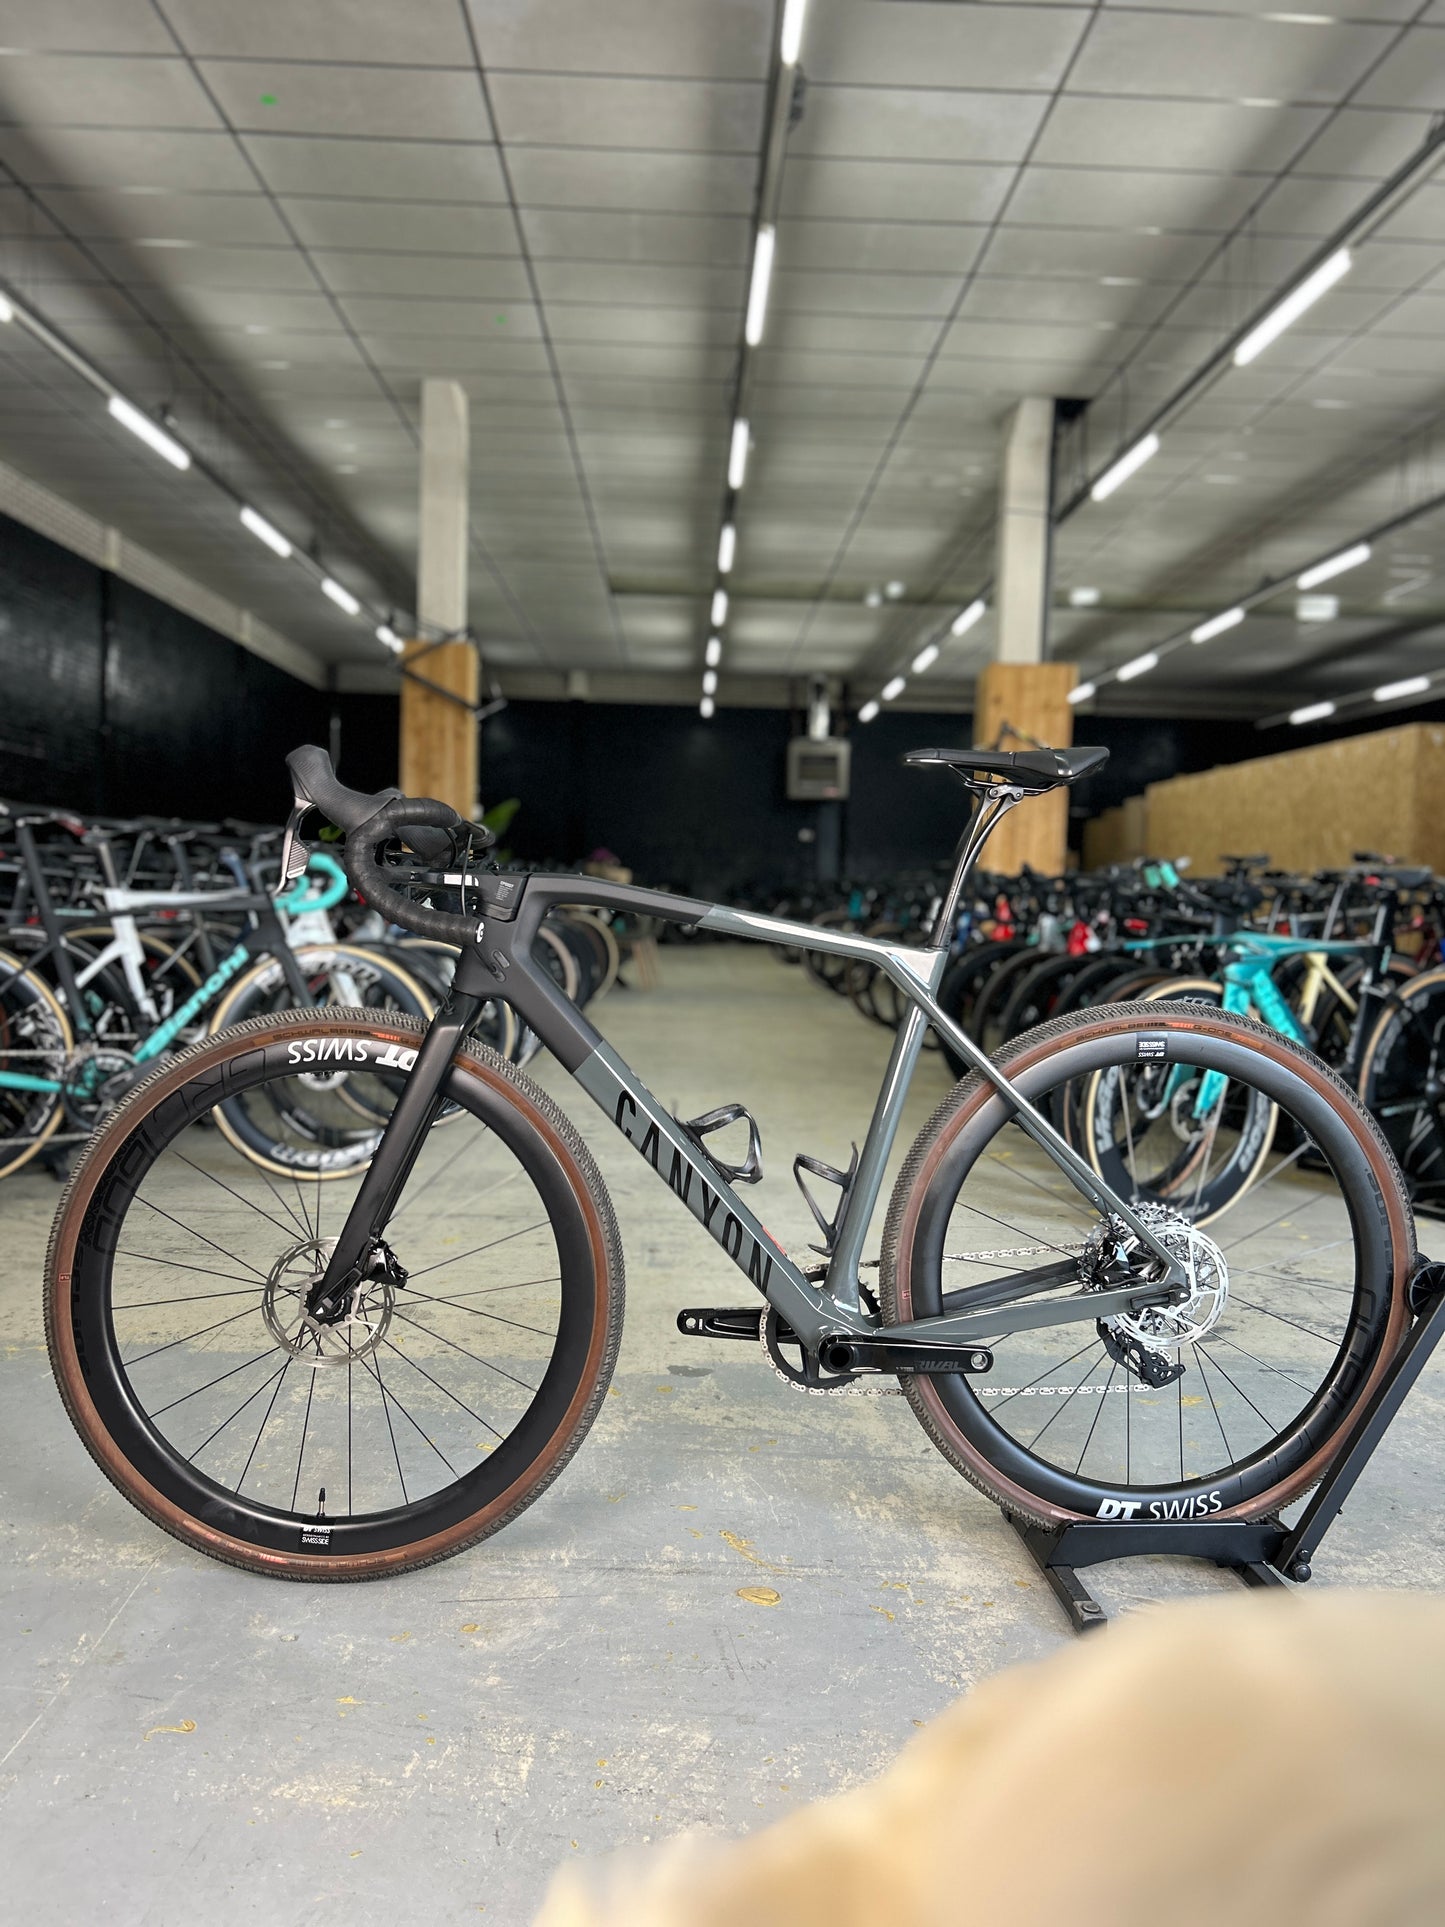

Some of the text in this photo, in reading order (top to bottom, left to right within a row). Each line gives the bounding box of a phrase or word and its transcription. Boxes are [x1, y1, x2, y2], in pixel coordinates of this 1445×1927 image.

[287, 1038, 372, 1064] SWISS
[615, 1089, 772, 1298] CANYON
[1096, 1490, 1222, 1520] DT SWISS
